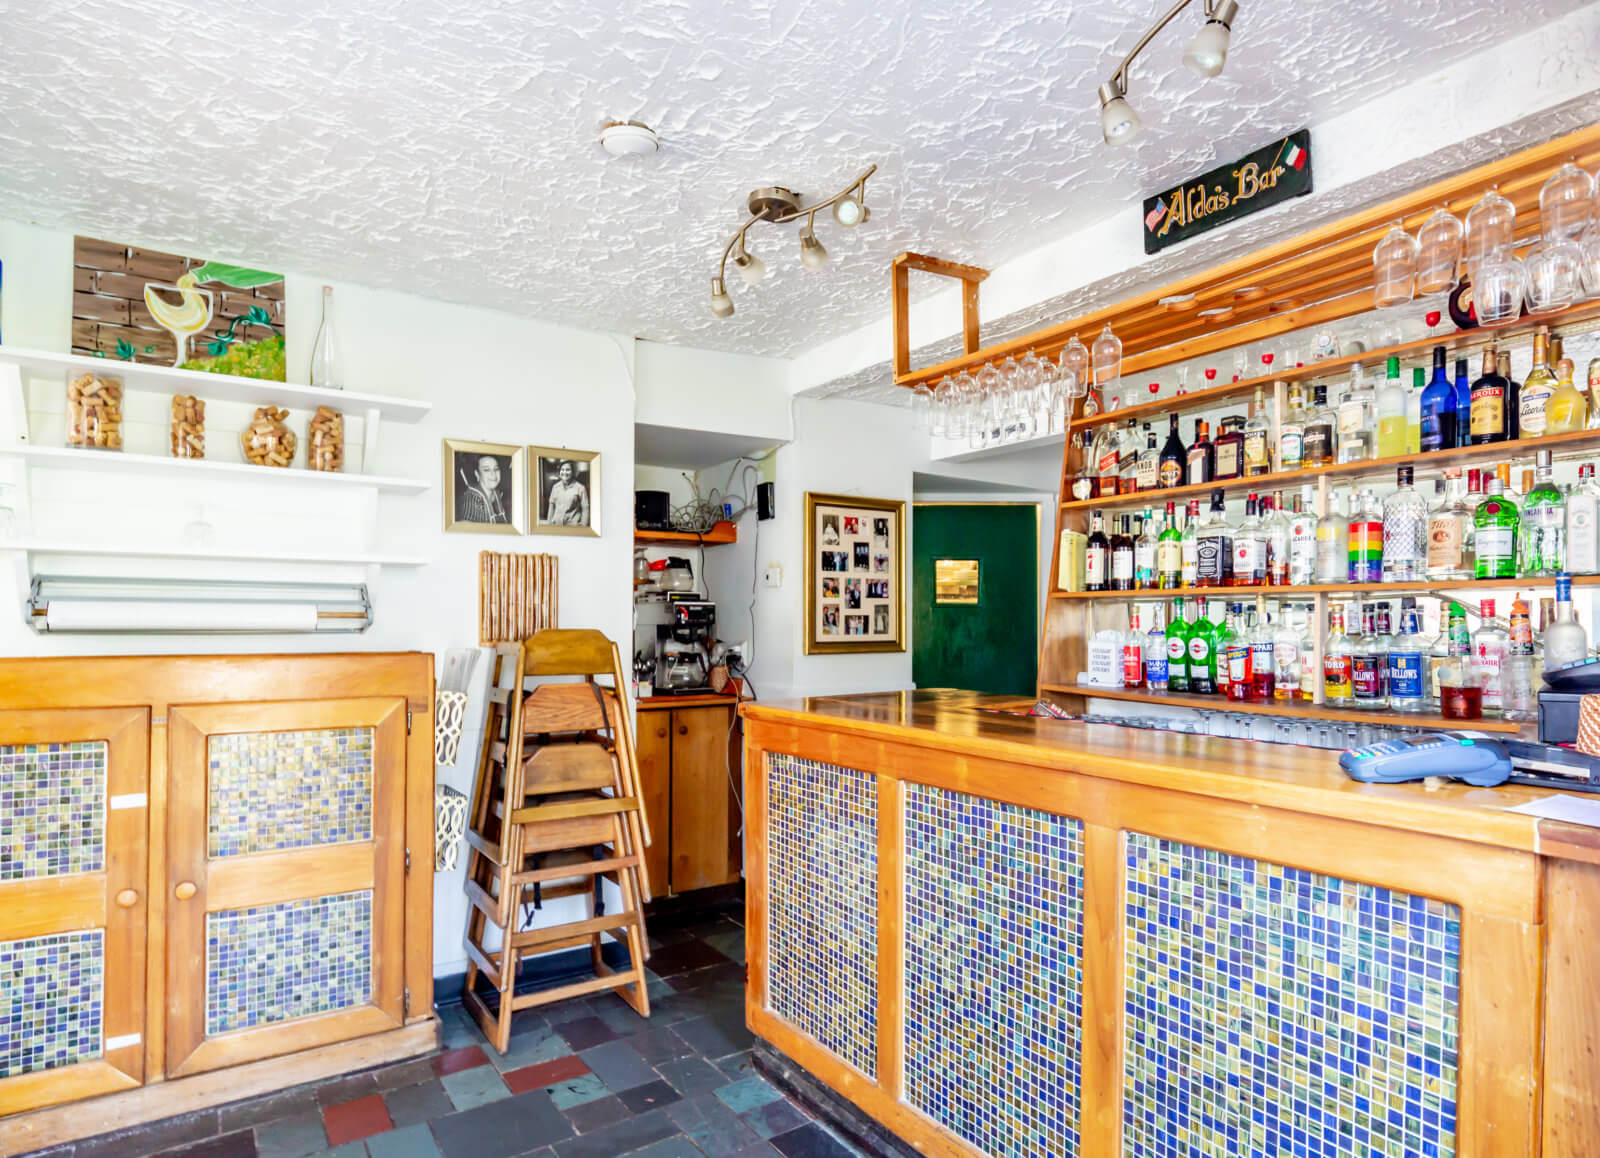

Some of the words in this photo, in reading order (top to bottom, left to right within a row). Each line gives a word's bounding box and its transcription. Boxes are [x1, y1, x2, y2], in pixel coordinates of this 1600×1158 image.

[1157, 184, 1230, 238] Alda's
[1232, 163, 1285, 206] Bar
[1353, 671, 1375, 681] ELLOWS
